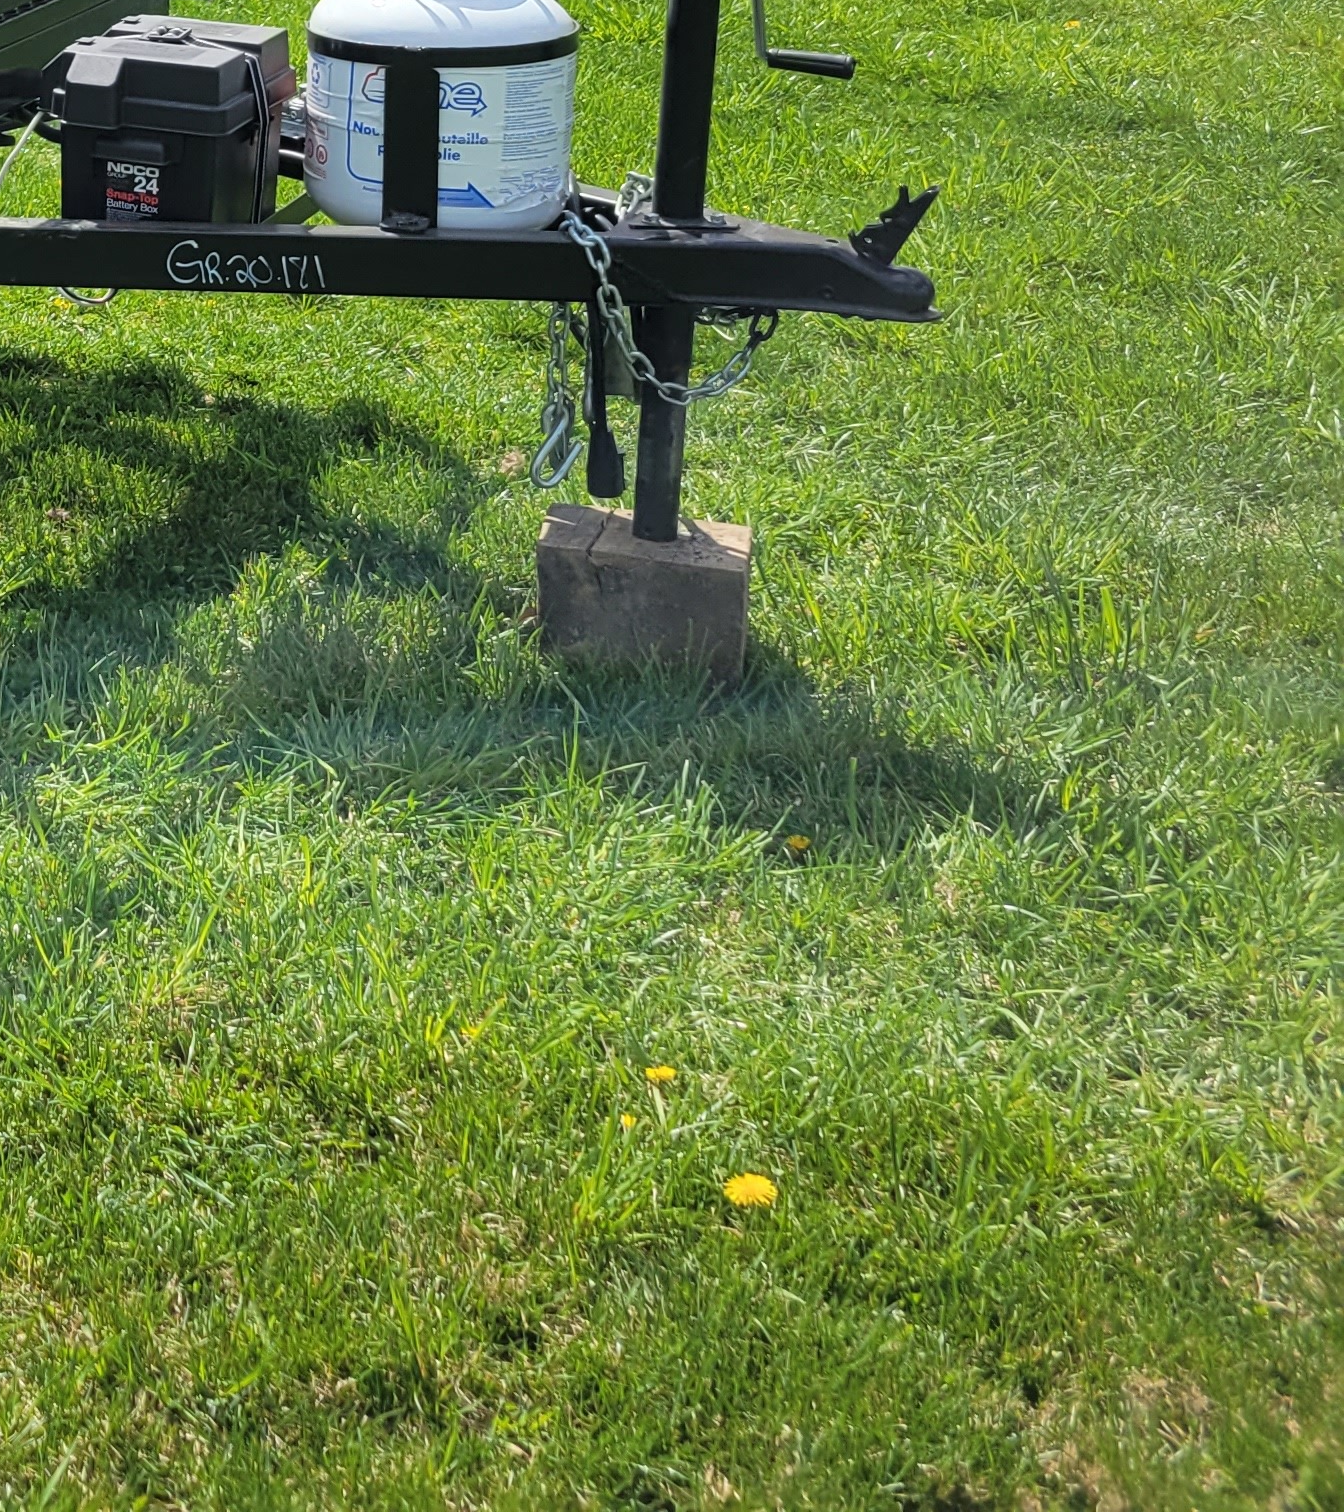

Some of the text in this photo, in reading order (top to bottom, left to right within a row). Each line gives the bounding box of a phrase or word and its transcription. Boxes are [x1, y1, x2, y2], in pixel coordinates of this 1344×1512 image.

[106, 161, 160, 178] NOCO
[133, 176, 160, 195] 24
[106, 188, 159, 206] Snap-Top
[106, 198, 139, 213] Battery
[140, 202, 159, 214] Box
